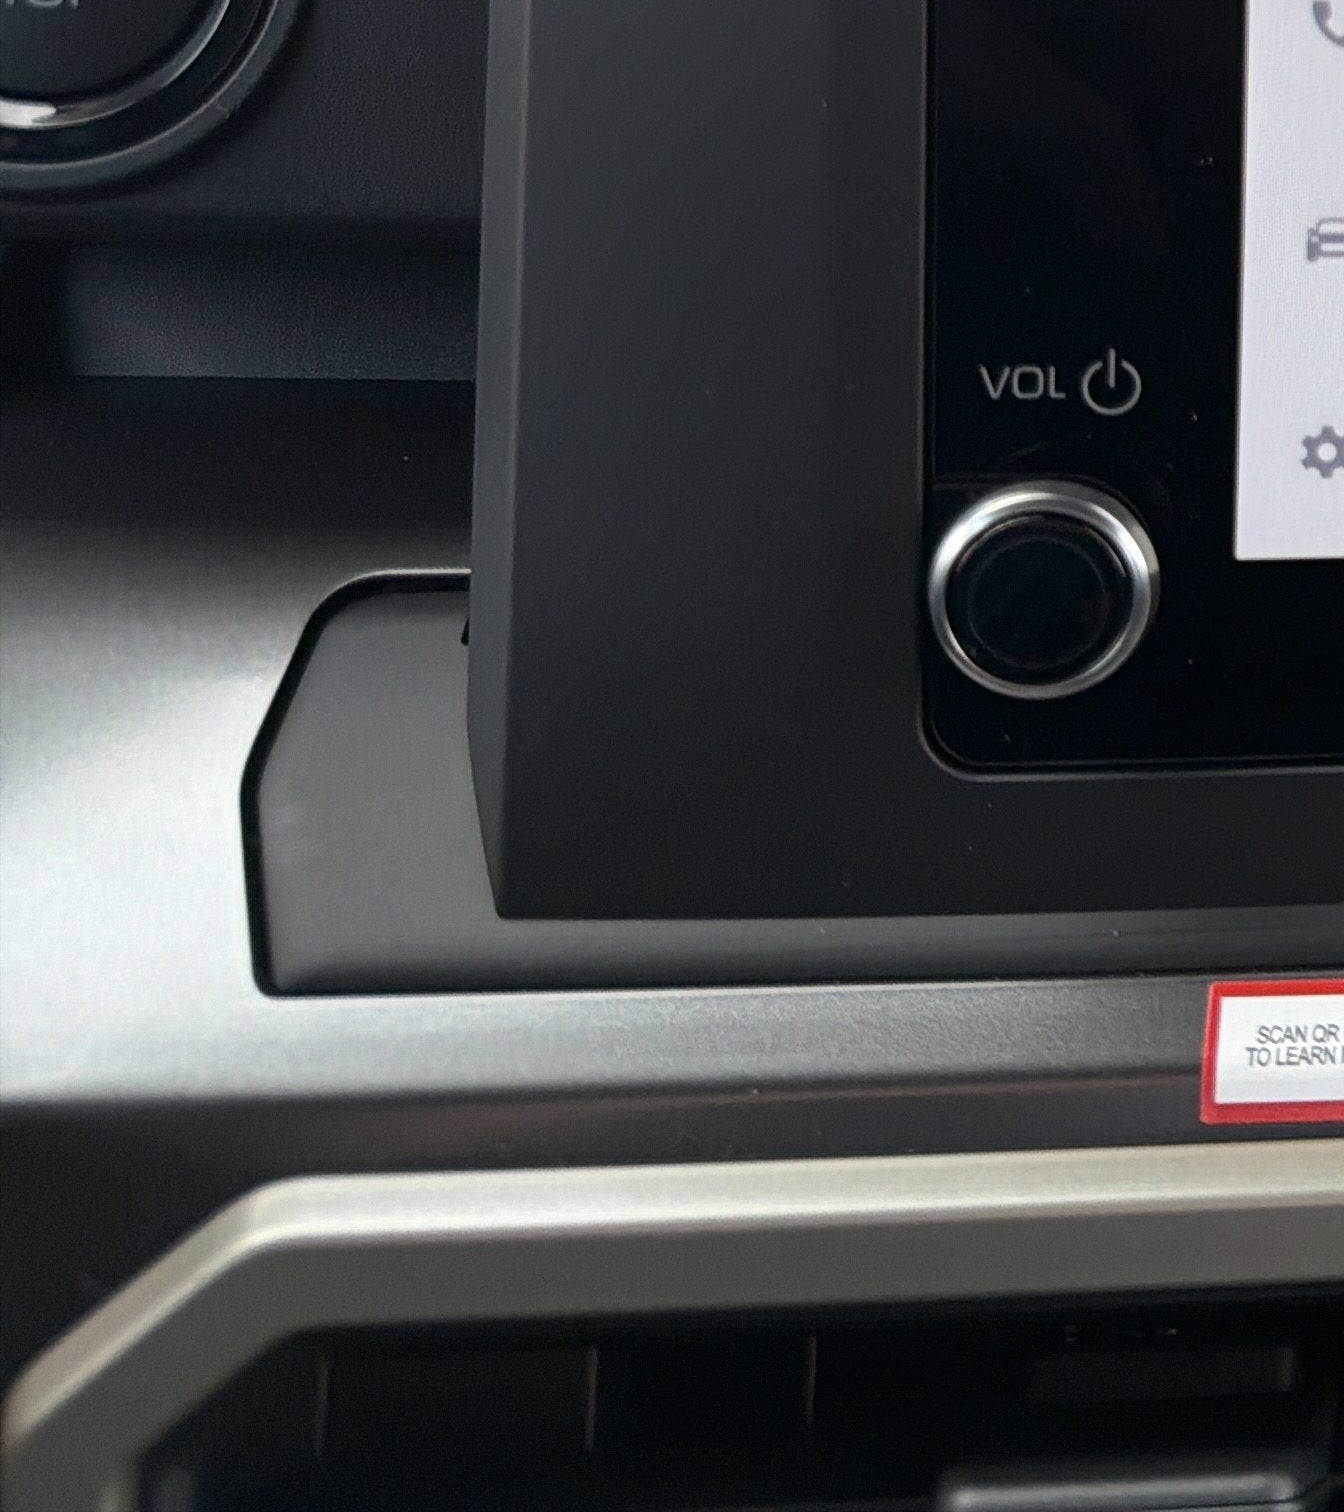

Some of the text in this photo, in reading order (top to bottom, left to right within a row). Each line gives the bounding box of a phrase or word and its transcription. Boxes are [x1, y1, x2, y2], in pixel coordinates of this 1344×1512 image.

[978, 363, 1067, 401] VOL
[1256, 1023, 1308, 1045] SCAN
[1311, 1023, 1341, 1044] QR
[1245, 1046, 1272, 1068] TO
[1275, 1045, 1338, 1066] LEARN
